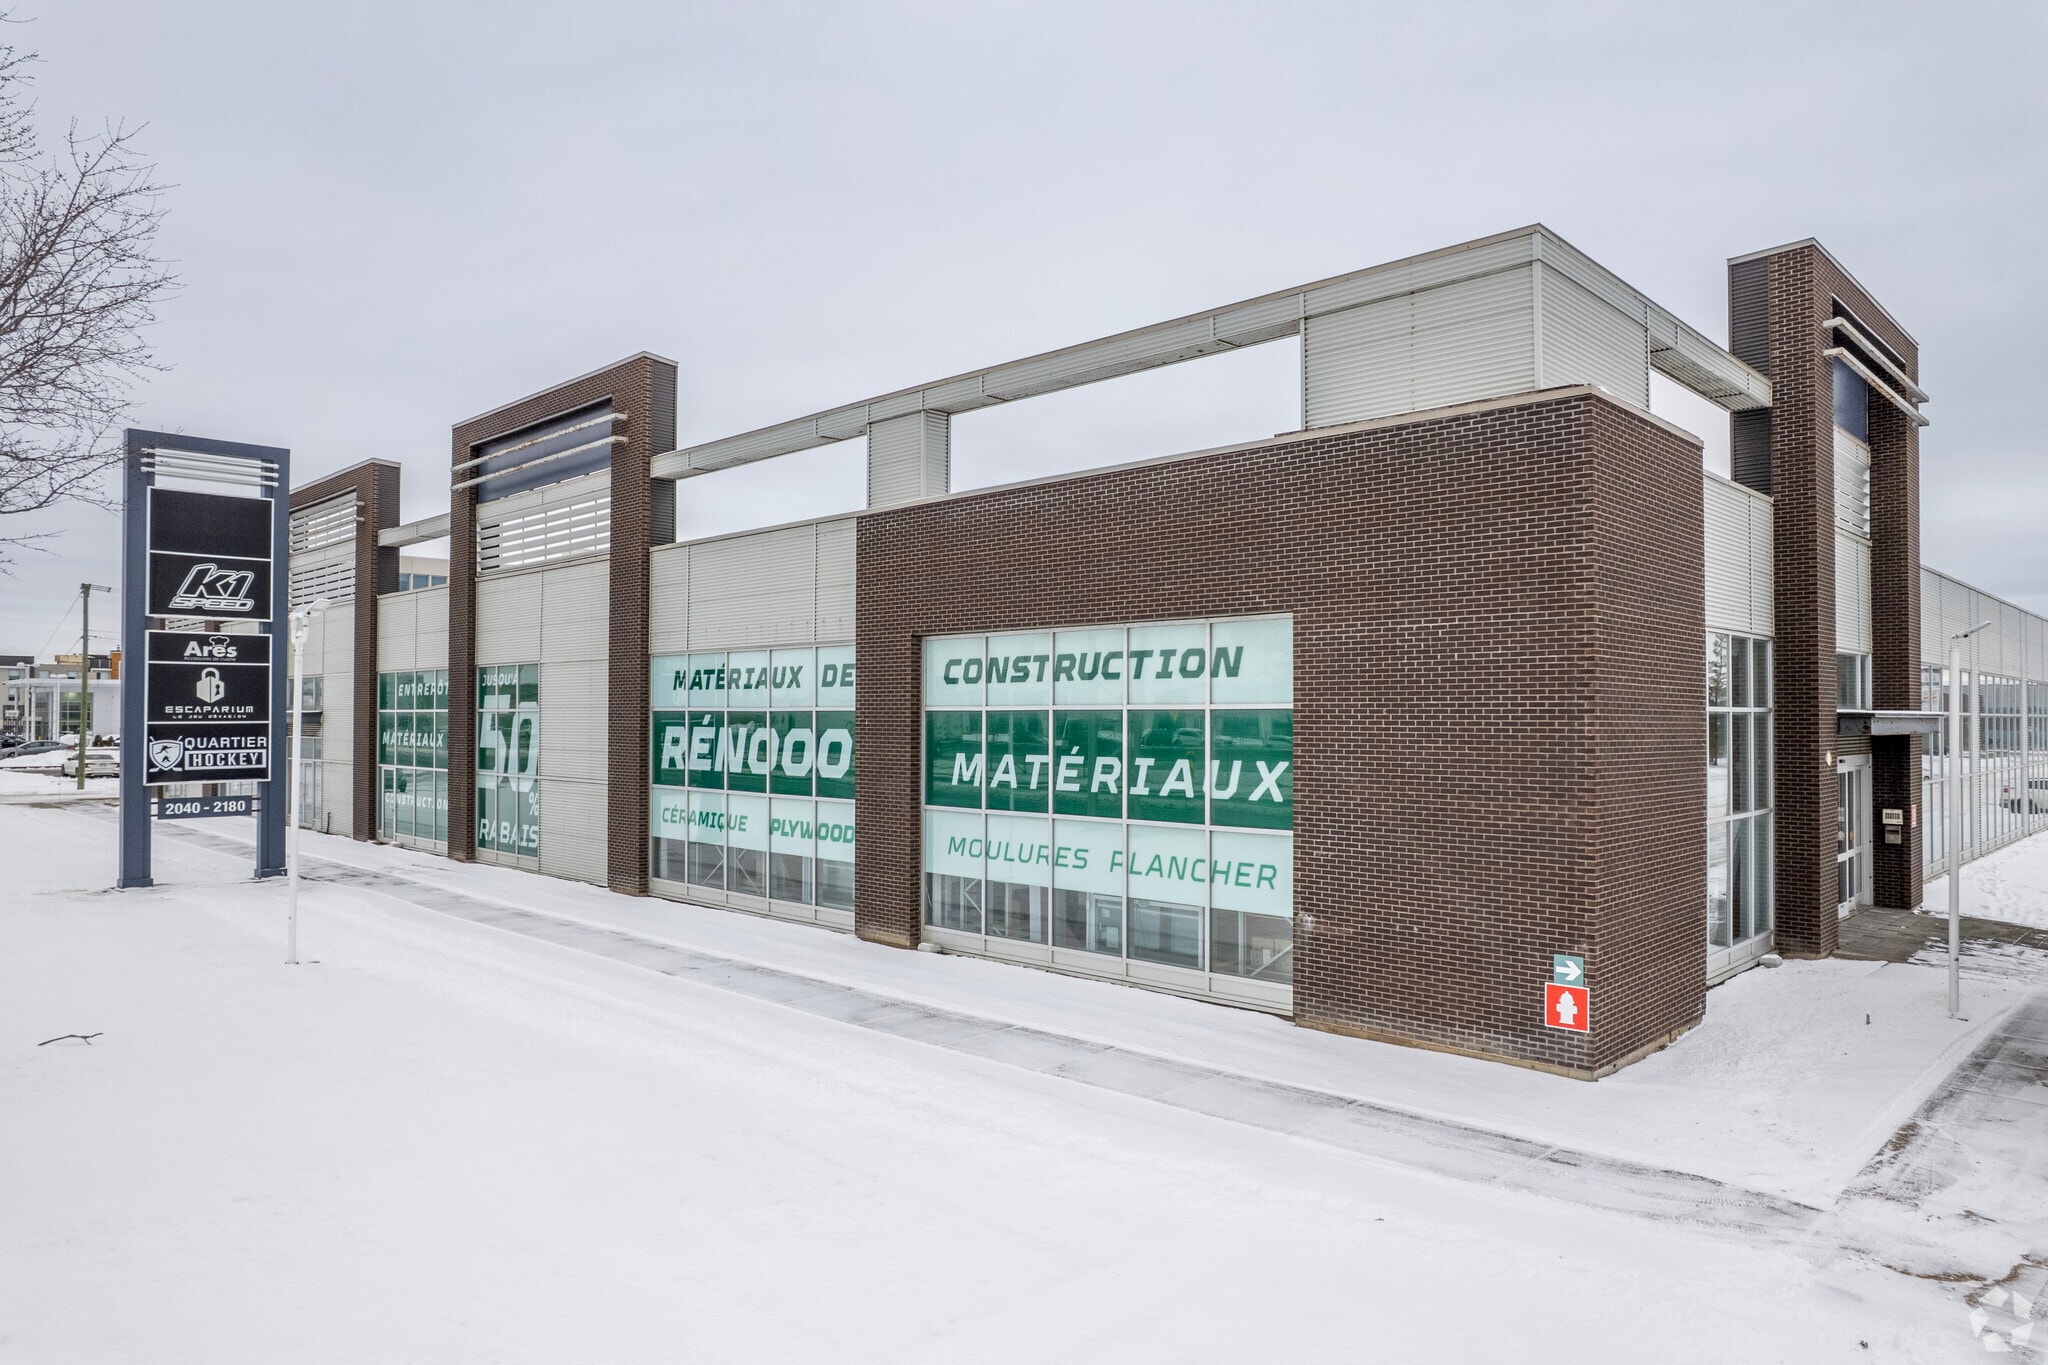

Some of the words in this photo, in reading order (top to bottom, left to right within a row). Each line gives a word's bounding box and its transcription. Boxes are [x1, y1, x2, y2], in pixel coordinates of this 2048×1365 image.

[178, 562, 255, 600] K1
[168, 597, 254, 611] SPEED
[183, 640, 238, 658] Ares
[673, 662, 804, 691] MATÉRIAUX
[821, 663, 856, 688] DE
[943, 646, 1244, 685] CONSTRUCTION
[165, 705, 254, 714] ESCAPARIUM
[184, 736, 267, 750] QUARTIER
[382, 729, 444, 748] MATÉRIAUX
[478, 694, 539, 793] 50
[192, 752, 259, 767] HOCKEY
[951, 746, 1290, 803] MATÉRIAUX
[165, 802, 201, 814] 2040
[213, 800, 246, 813] 2180
[479, 818, 539, 848] RABAIS
[662, 804, 748, 833] CÉRAMIQUE
[769, 818, 856, 844] PLYWOOD
[948, 836, 1089, 870] MOULURES
[1109, 850, 1278, 890] PLANCHER
